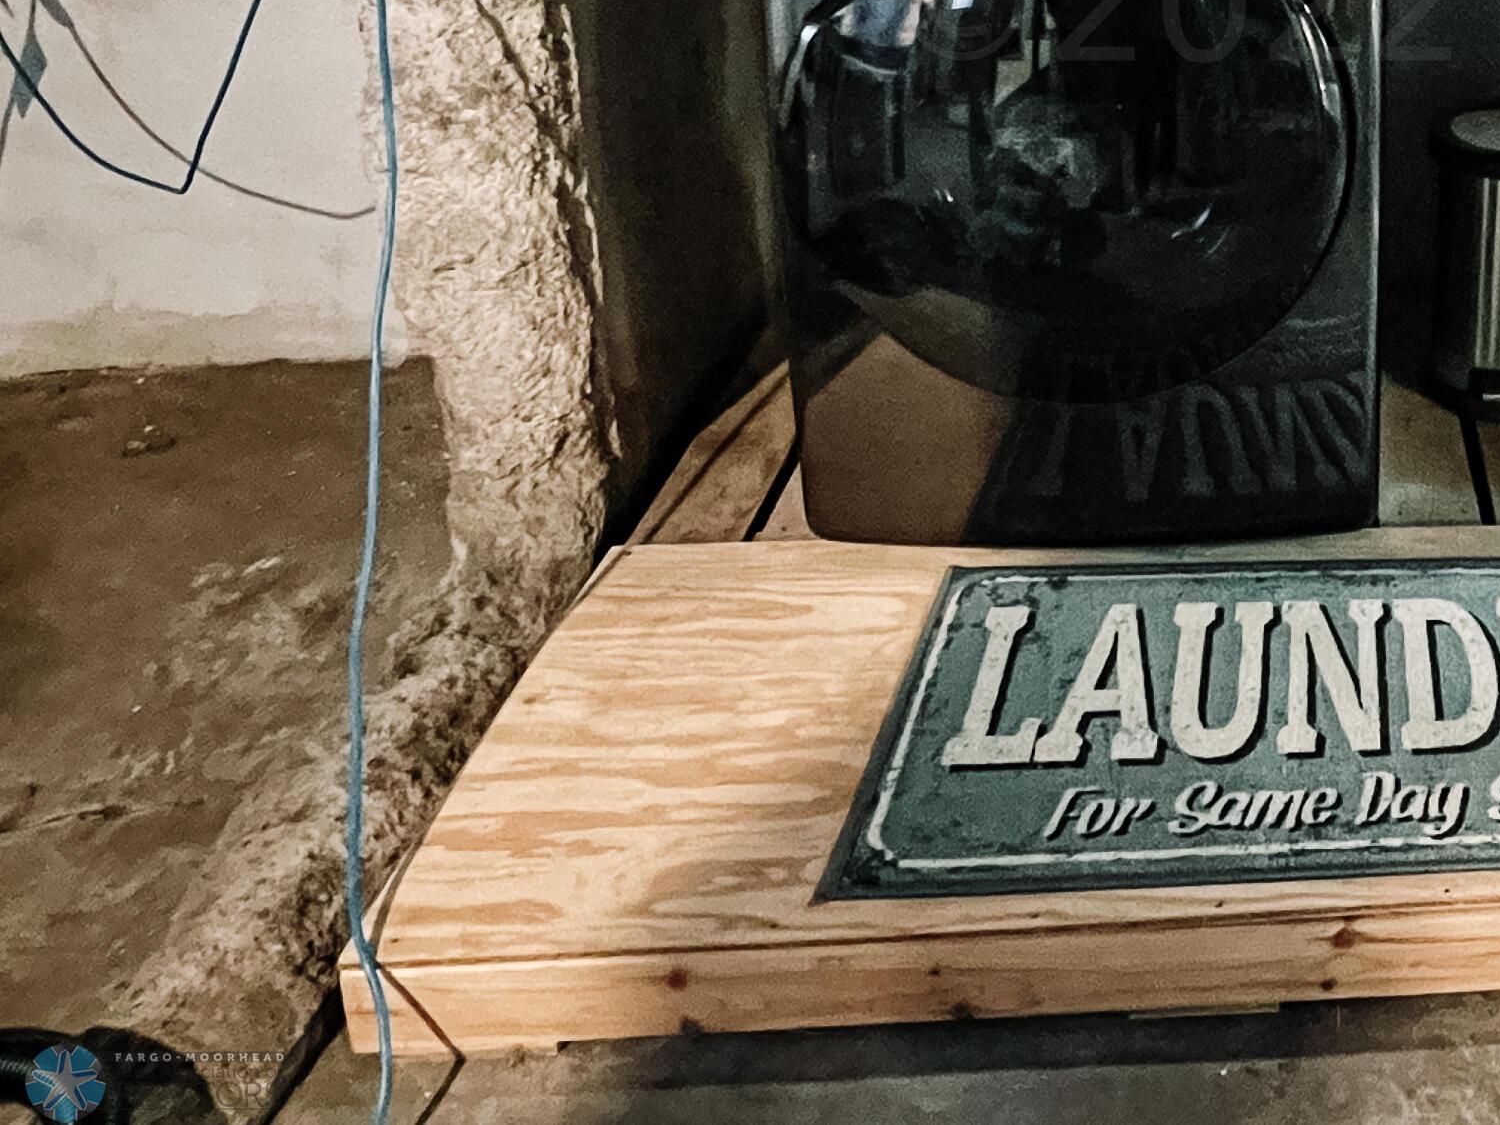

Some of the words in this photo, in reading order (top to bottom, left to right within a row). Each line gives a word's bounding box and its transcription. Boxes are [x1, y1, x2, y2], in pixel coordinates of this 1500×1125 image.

[1043, 784, 1154, 842] For
[1168, 779, 1343, 838] Same
[1354, 769, 1470, 840] Day
